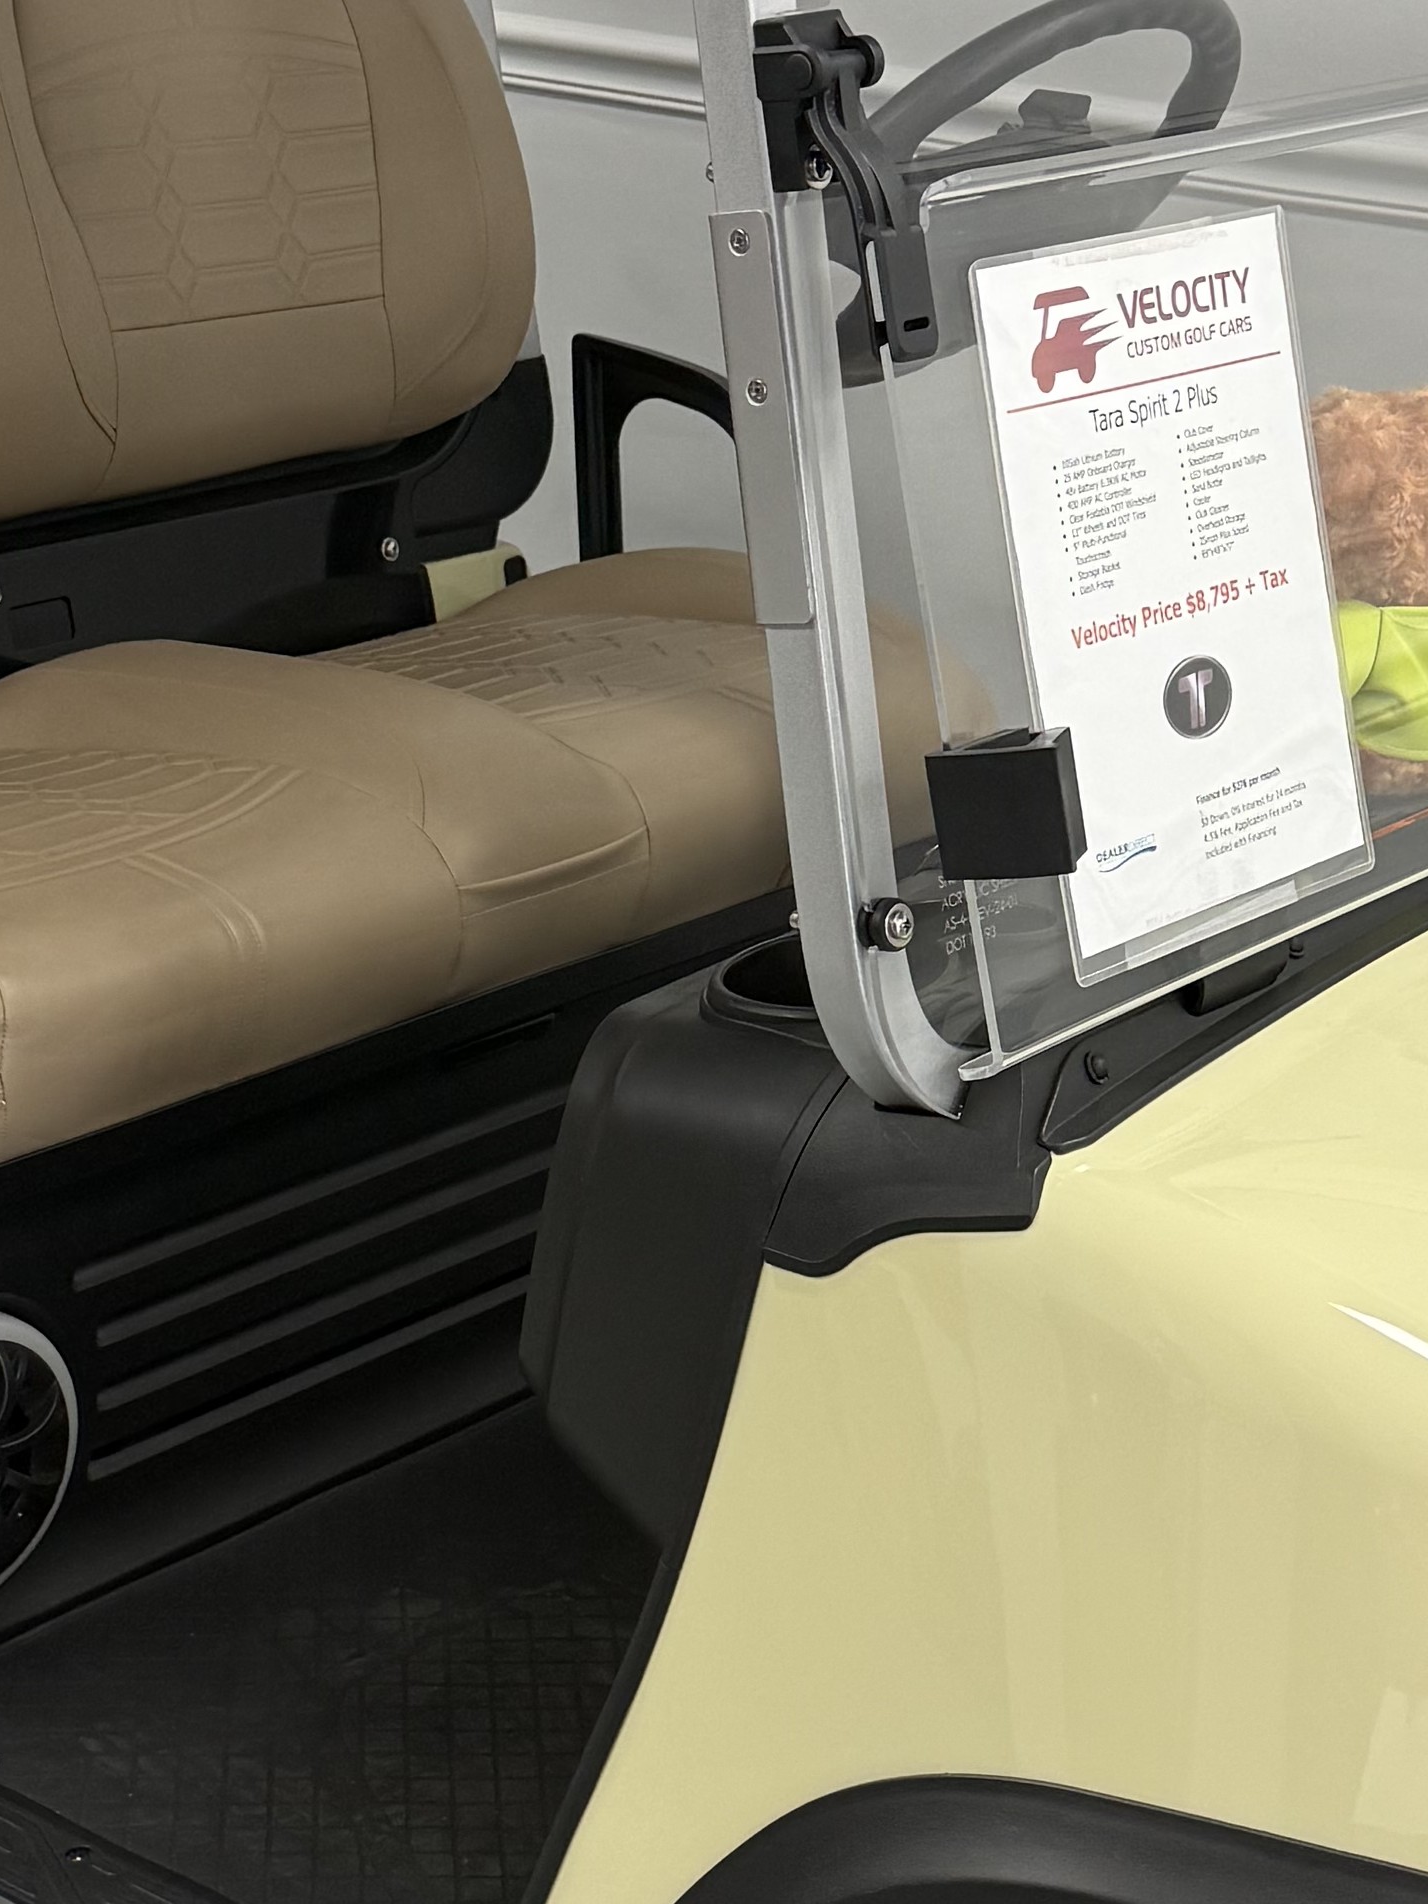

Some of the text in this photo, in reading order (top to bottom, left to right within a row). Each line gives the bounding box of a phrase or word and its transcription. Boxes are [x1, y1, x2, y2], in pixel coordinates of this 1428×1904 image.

[1117, 267, 1250, 329] VELOCITY
[1126, 315, 1253, 359] CUSTOM GOLF CARS
[1089, 383, 1218, 434] Tara Spirit 2 Plus
[1071, 566, 1289, 650] Velocity Price $8,795 + Tax
[945, 934, 967, 956] DOT
